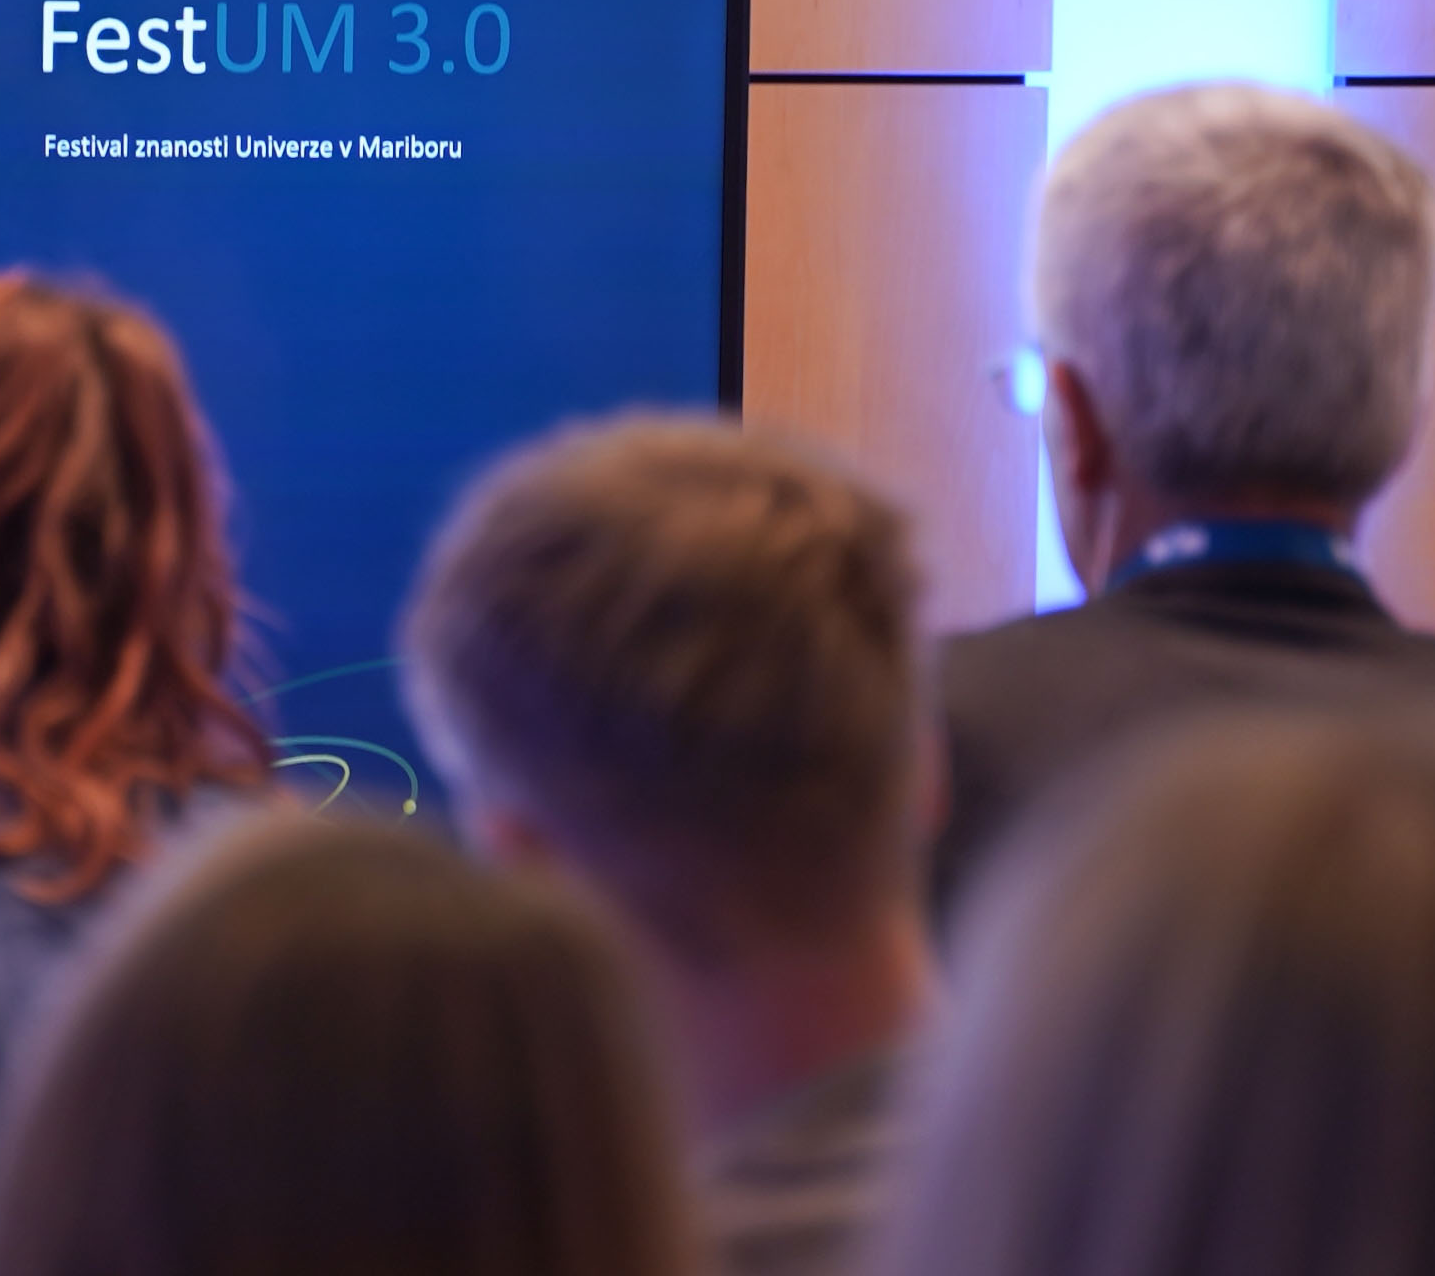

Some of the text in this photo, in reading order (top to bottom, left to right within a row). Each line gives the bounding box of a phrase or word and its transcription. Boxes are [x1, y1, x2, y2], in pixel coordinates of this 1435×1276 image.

[42, 0, 511, 74] FestUM 3.0
[44, 133, 463, 160] Festival znanosti Univerze v Mariboru
